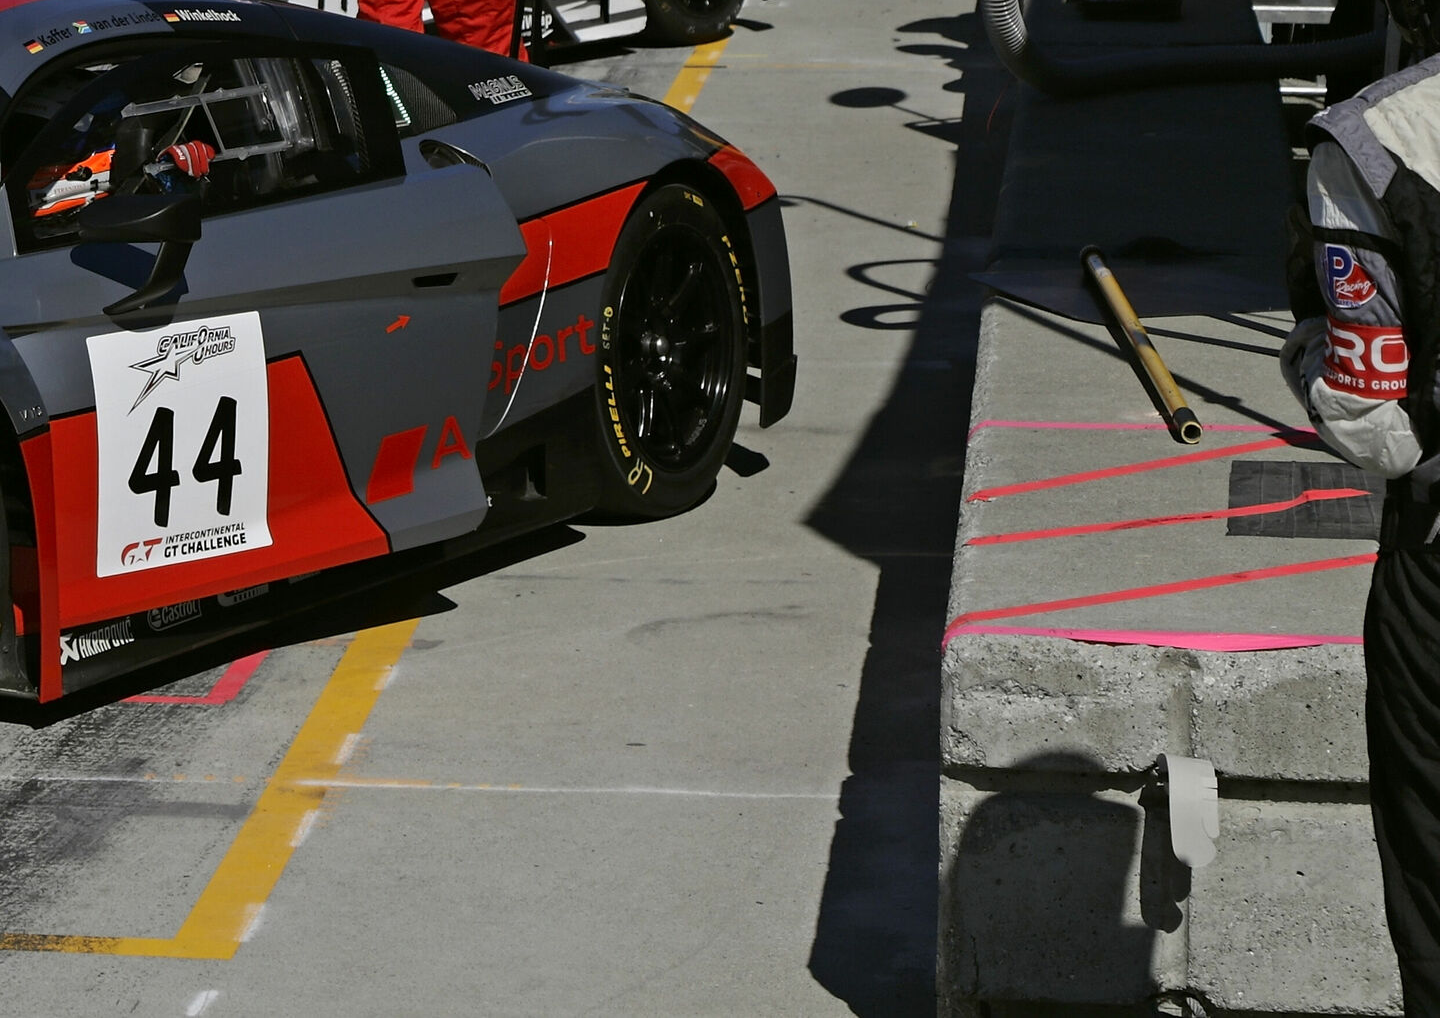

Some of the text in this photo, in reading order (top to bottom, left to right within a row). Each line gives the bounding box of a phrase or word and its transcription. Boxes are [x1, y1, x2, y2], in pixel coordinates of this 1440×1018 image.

[38, 8, 242, 47] Kaffer van der Linde Winkelhock
[1335, 277, 1372, 298] Racing
[604, 364, 632, 458] PIRELLI
[128, 395, 242, 527] 44
[164, 533, 247, 558] GT CHALLENGE
[165, 522, 246, 544] INTERCONTINENTAL
[161, 599, 199, 625] Castrol
